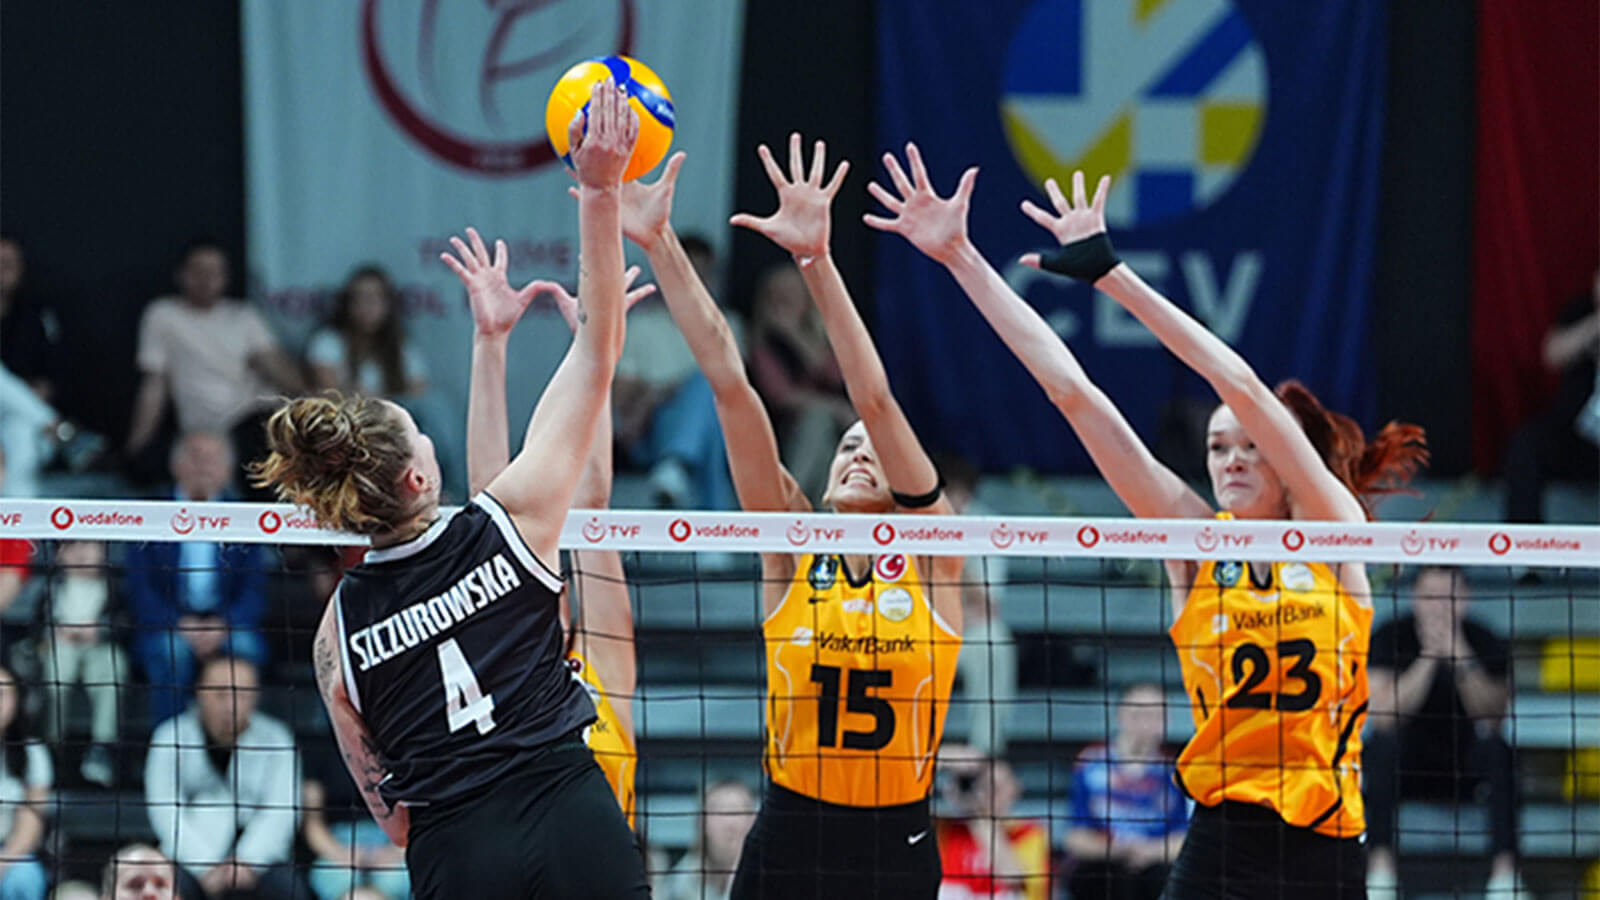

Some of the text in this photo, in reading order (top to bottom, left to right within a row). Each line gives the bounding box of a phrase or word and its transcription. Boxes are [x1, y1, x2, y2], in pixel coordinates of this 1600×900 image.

[78, 511, 145, 525] vodafone
[199, 516, 230, 529] TVF
[609, 524, 641, 537] TVF
[695, 524, 760, 537] vodafone
[814, 527, 845, 540] TVF
[899, 527, 964, 541] vodafone
[1017, 530, 1049, 543] TVF
[1103, 530, 1169, 543] vodafone
[1222, 533, 1254, 545] TVF
[1308, 533, 1374, 547] vodafone
[1428, 537, 1460, 549] TVF
[1516, 538, 1581, 551] vodafone
[350, 554, 521, 671] SZCZUROWSKA
[1227, 638, 1322, 712] 23
[437, 637, 497, 735] 4
[810, 664, 896, 751] 15
